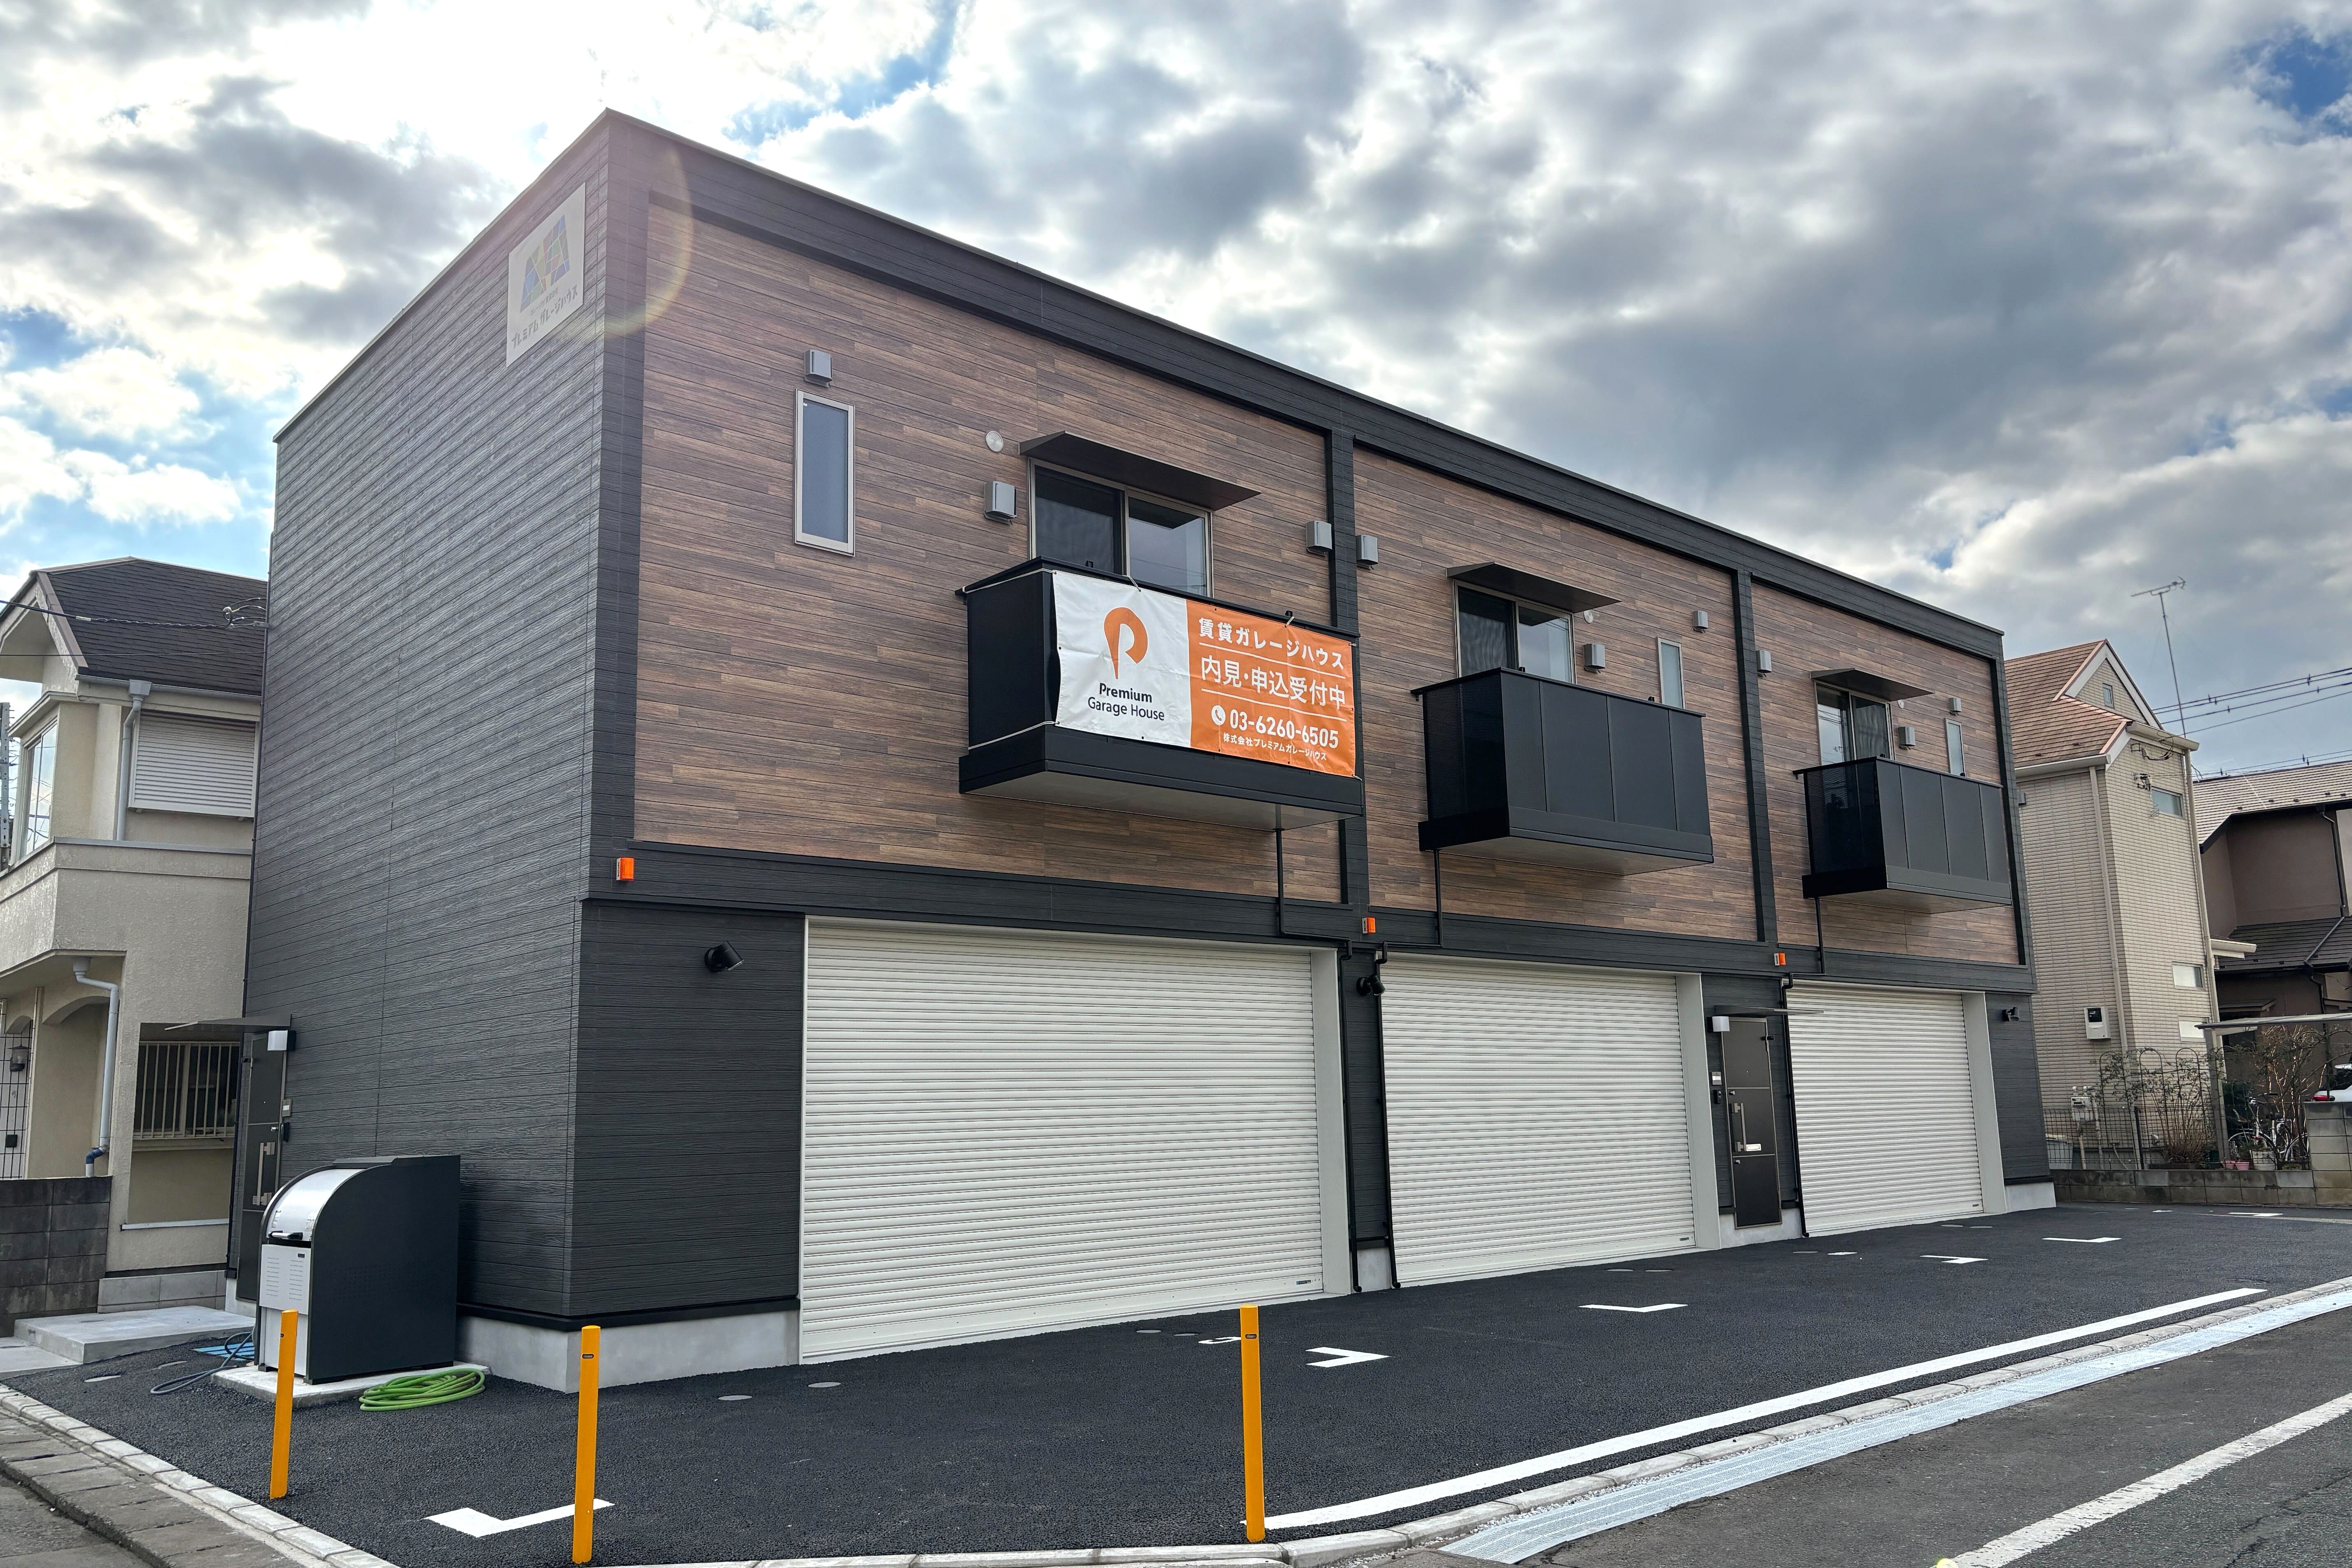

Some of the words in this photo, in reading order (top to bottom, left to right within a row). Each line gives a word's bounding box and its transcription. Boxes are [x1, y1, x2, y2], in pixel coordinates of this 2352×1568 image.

[1199, 617, 1344, 670] 賃貸ガレージハウス
[1099, 682, 1153, 703] Premium
[1201, 655, 1346, 710] 内見・申込受付中
[1087, 696, 1128, 716] Garage
[1131, 704, 1165, 721] House
[1230, 709, 1339, 749] 03-6260-6505
[1223, 732, 1327, 761] 株式会社プレミアムガレージハウス
